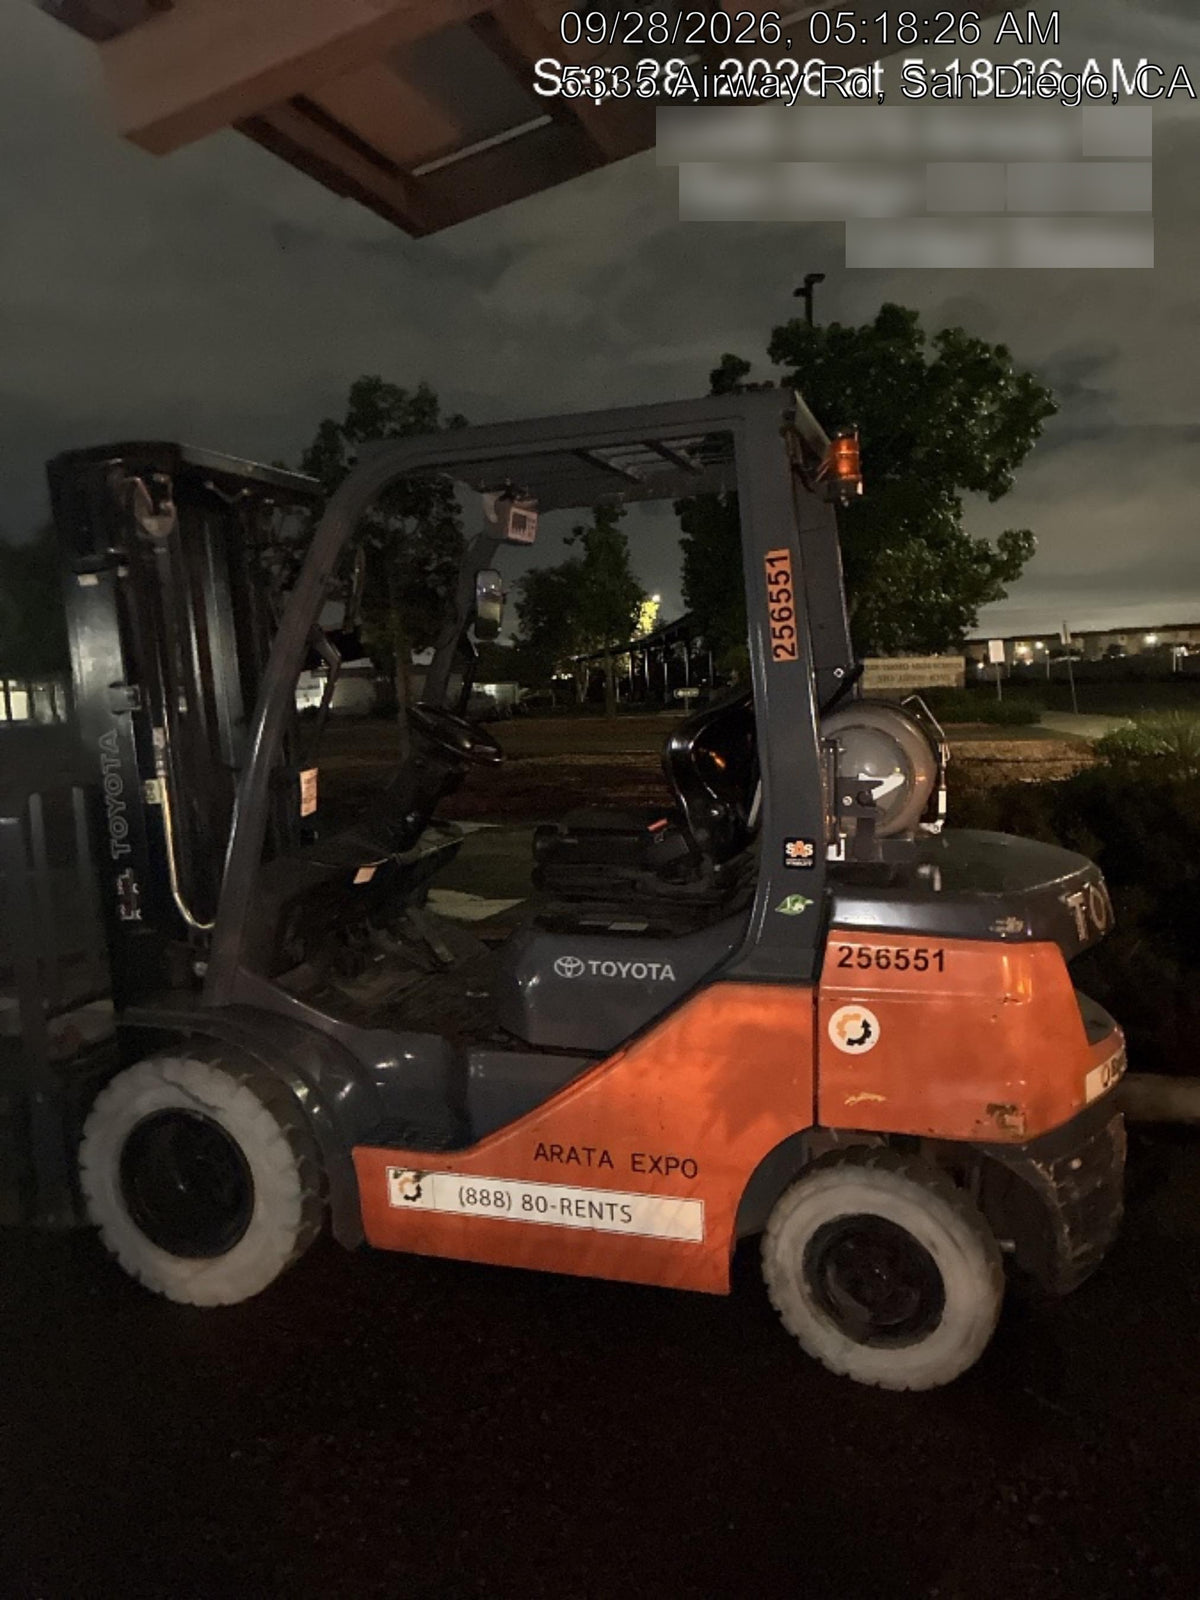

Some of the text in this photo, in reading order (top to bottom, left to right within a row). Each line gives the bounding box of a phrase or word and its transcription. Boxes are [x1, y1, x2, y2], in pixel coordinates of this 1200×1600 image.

[766, 555, 796, 659] 256551
[100, 728, 132, 860] TOYOTA
[587, 960, 676, 982] TOYOTA
[837, 945, 945, 973] 256551
[533, 1142, 699, 1180] ARATA EXPO
[458, 1185, 633, 1224] (888) 80-RENTS
